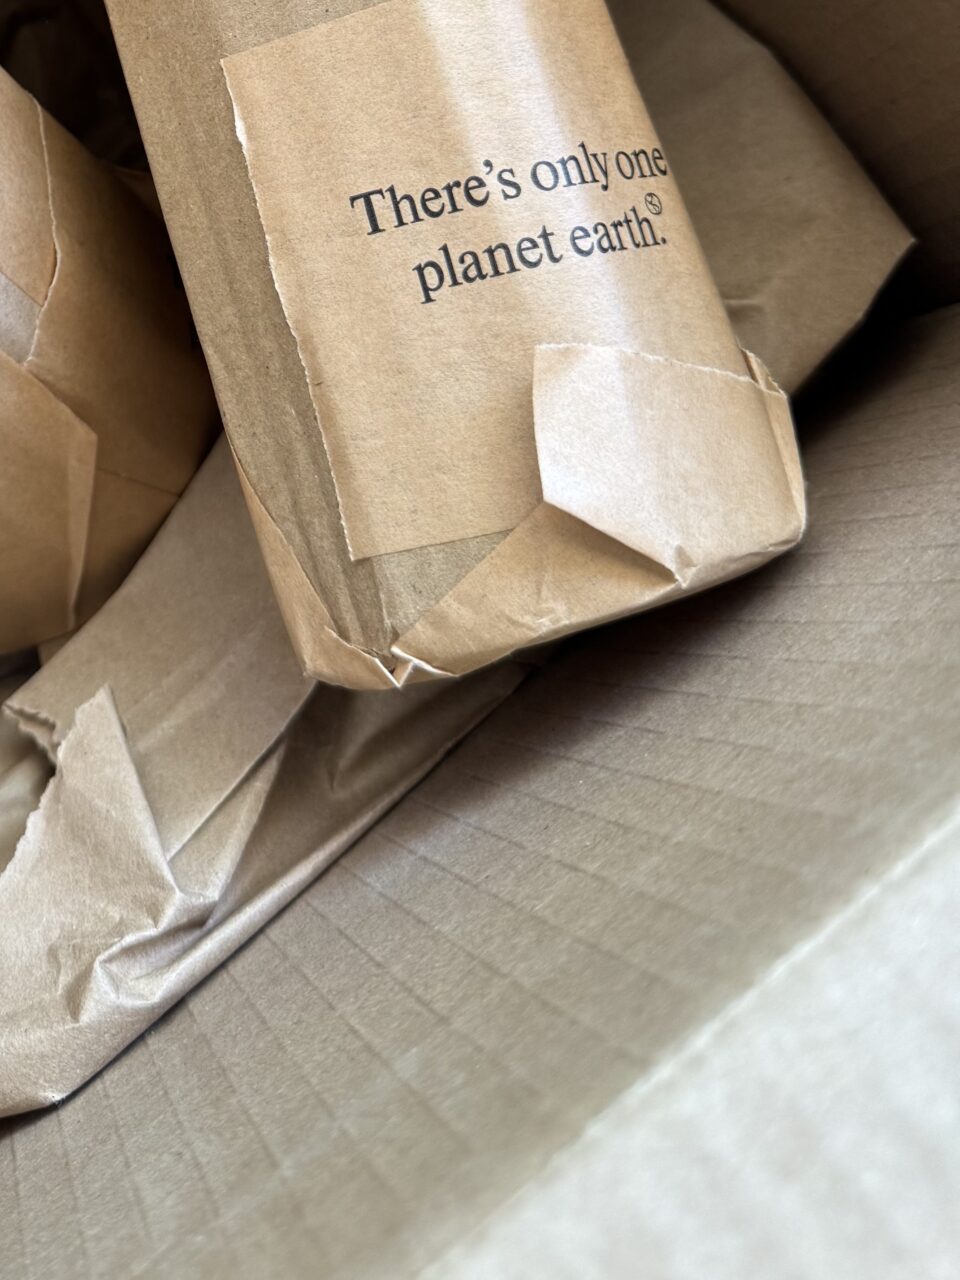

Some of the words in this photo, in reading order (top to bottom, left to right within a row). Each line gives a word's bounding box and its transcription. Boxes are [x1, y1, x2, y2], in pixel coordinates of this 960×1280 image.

[349, 159, 522, 236] There's
[530, 141, 608, 191] only
[615, 146, 668, 179] one
[411, 225, 563, 305] planet
[569, 206, 667, 257] earth.
